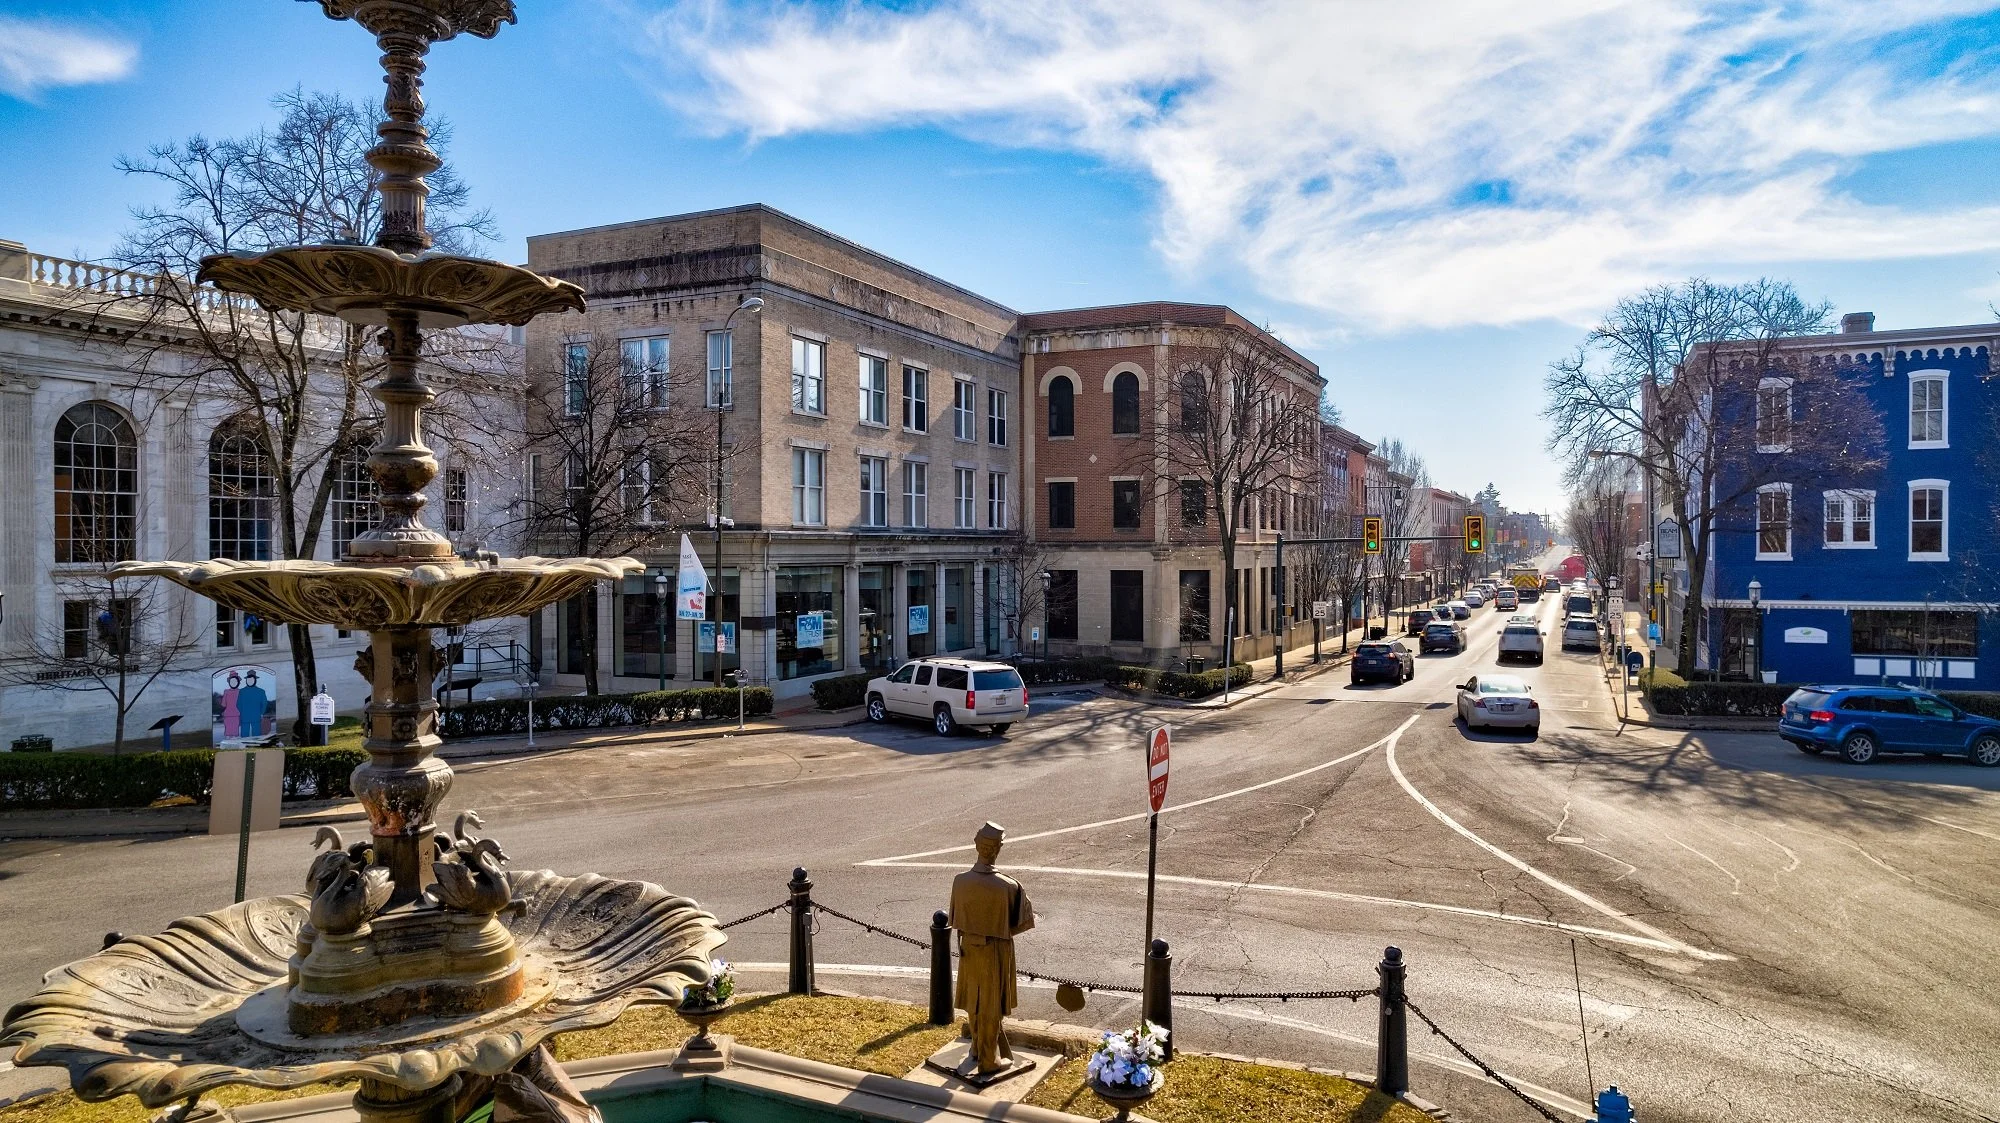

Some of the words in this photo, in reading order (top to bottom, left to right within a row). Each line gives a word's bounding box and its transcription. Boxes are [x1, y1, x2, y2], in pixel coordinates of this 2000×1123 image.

[910, 607, 928, 620] F&M
[798, 616, 821, 631] F&M
[1152, 780, 1164, 798] ENTER
